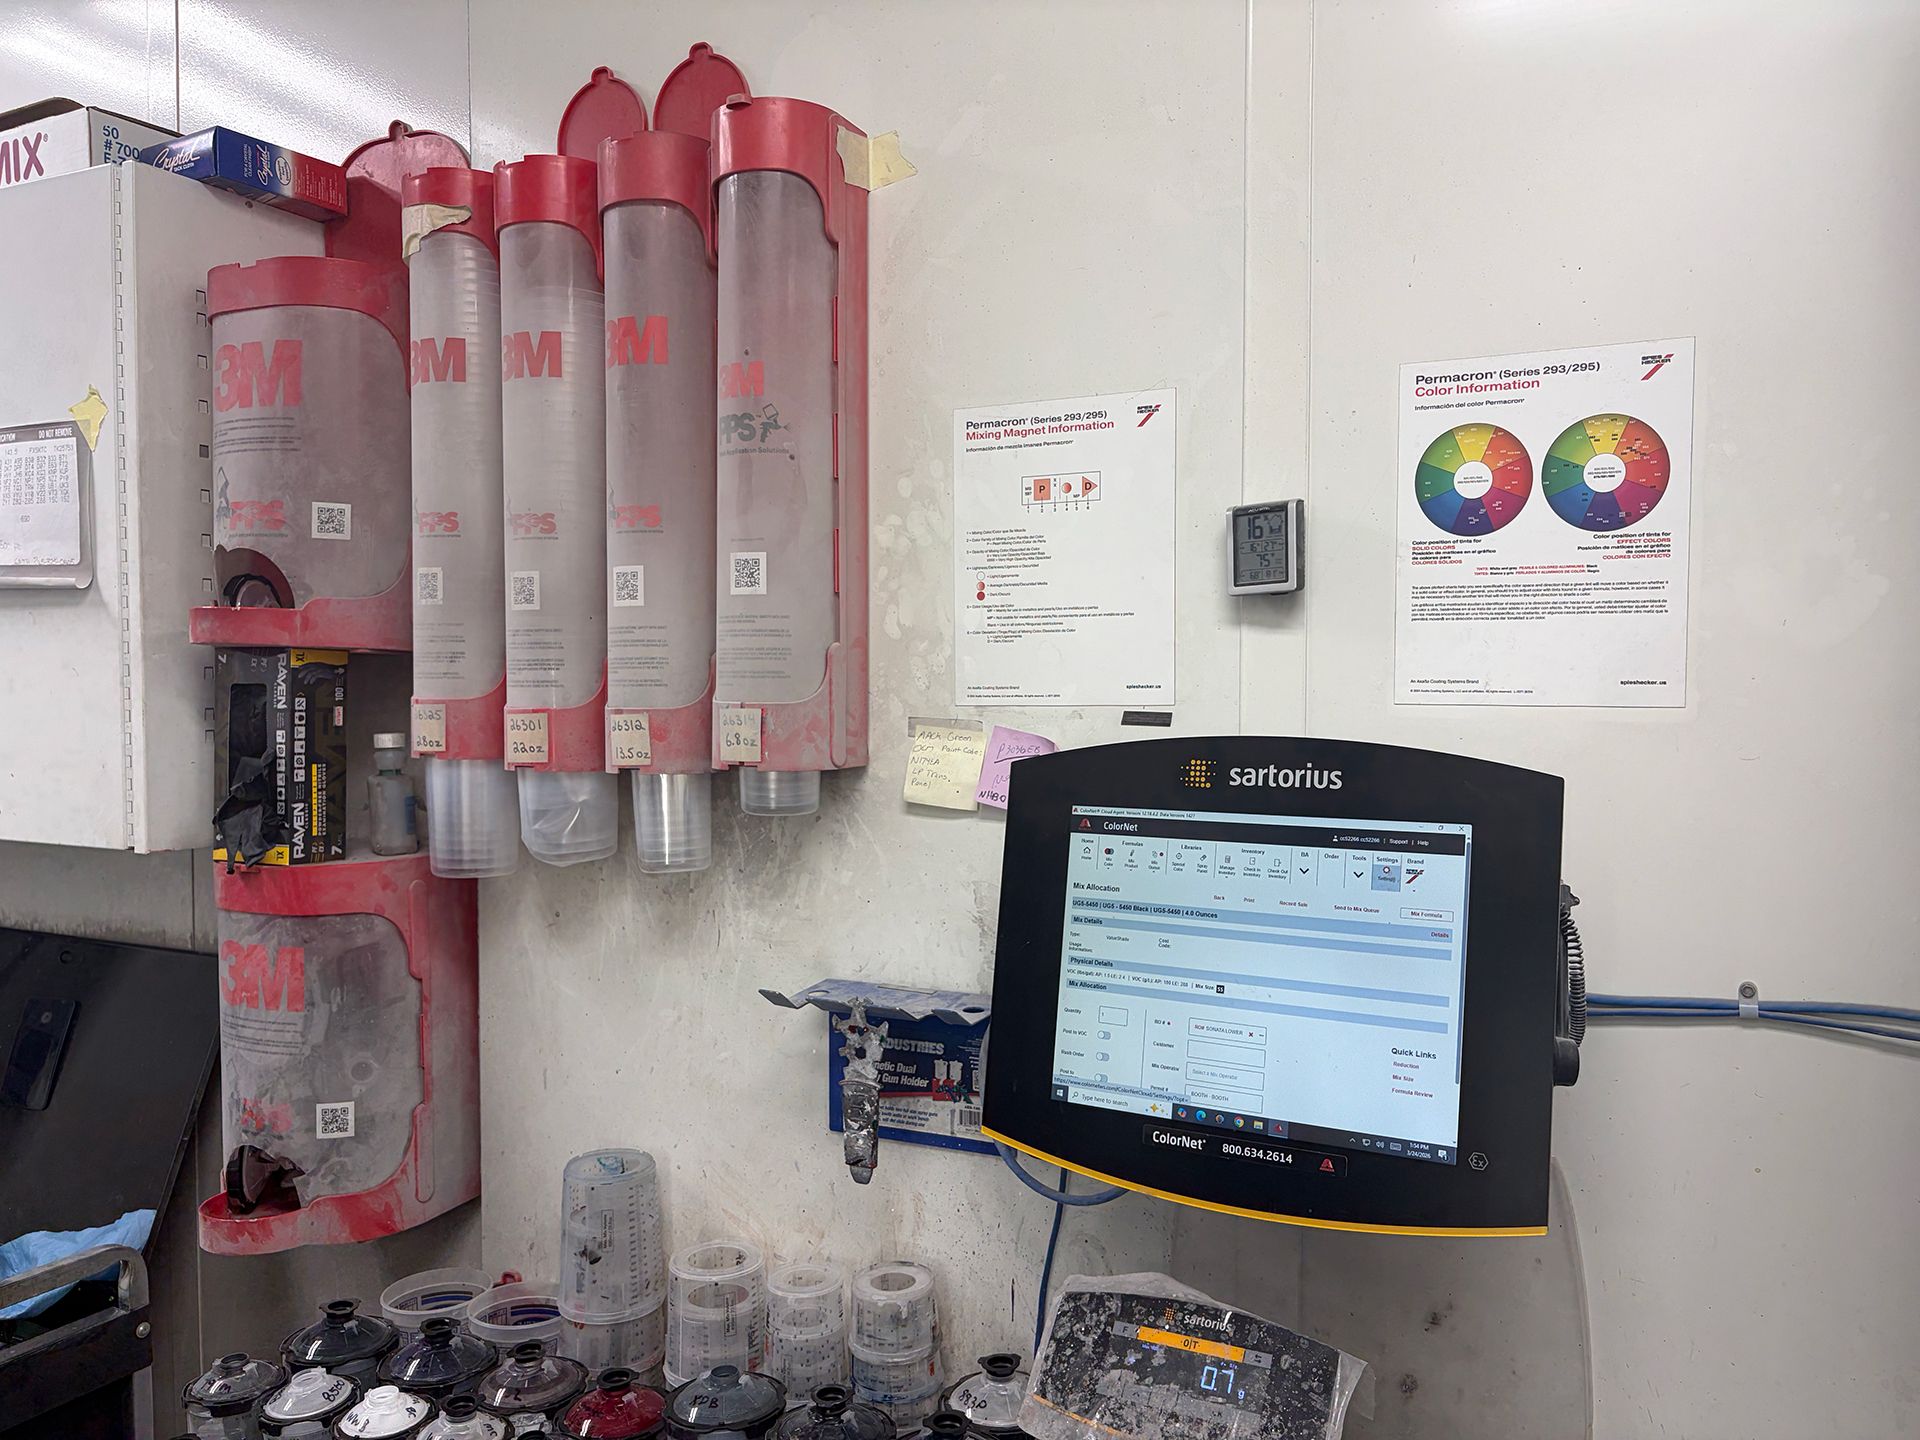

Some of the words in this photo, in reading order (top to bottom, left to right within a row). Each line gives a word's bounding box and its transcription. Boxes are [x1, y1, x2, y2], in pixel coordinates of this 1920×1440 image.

[103, 125, 119, 140] 50
[607, 316, 669, 369] 3M
[503, 331, 563, 383] 3M
[214, 339, 303, 412] 3M
[1499, 367, 1541, 380] (Series
[1543, 361, 1601, 376] 293/295)
[1415, 384, 1454, 398] Color
[1456, 379, 1541, 395] Information
[1455, 401, 1466, 409] del
[1467, 400, 1485, 408] color
[1030, 415, 1062, 426] (Series
[1063, 410, 1108, 423] 293/295)
[966, 430, 1001, 442] Mixing
[1003, 426, 1046, 440] Magnet
[1048, 420, 1115, 435] Information
[1039, 485, 1046, 494] P
[1084, 482, 1092, 491] D
[1248, 516, 1264, 541] 16
[1611, 532, 1637, 540] position
[1428, 539, 1452, 547] position
[275, 653, 289, 710] RAVEN
[947, 731, 972, 742] Green
[1229, 763, 1343, 790] sartorius
[291, 801, 306, 859] RAVEN
[1103, 821, 1139, 832] ColorNet
[1121, 840, 1144, 848] Formulas
[1417, 839, 1430, 847] Help
[1241, 848, 1266, 856] Inventory
[1376, 856, 1399, 865] Settings
[1073, 882, 1086, 890] Mix
[1086, 883, 1121, 893] Allocation
[1118, 904, 1132, 912] 5450
[1133, 904, 1150, 914] Black
[1184, 910, 1195, 918] 4.0
[1195, 911, 1219, 920] Ounces
[1073, 916, 1084, 924] Mix
[1084, 917, 1104, 926] Details
[1430, 930, 1450, 939] Details
[1070, 956, 1094, 967] Physical
[1094, 958, 1114, 968] Details
[221, 940, 304, 1012] 3M
[1068, 979, 1080, 988] Mix
[1080, 981, 1108, 991] Allocation
[1391, 1047, 1414, 1057] Quick
[1415, 1050, 1437, 1060] Links
[896, 1062, 917, 1074] Dual
[1392, 1060, 1420, 1070] Reduction
[882, 1073, 899, 1084] Gun
[900, 1074, 930, 1088] Holder
[1391, 1087, 1413, 1096] Formula
[1413, 1089, 1434, 1099] Review
[1081, 1093, 1093, 1102] Type
[1092, 1095, 1105, 1103] here
[1112, 1098, 1129, 1107] search
[1222, 1143, 1293, 1164] 800.634.2614
[1183, 1314, 1232, 1333] sartorius
[1121, 1326, 1129, 1334] F
[1237, 1389, 1245, 1400] g
